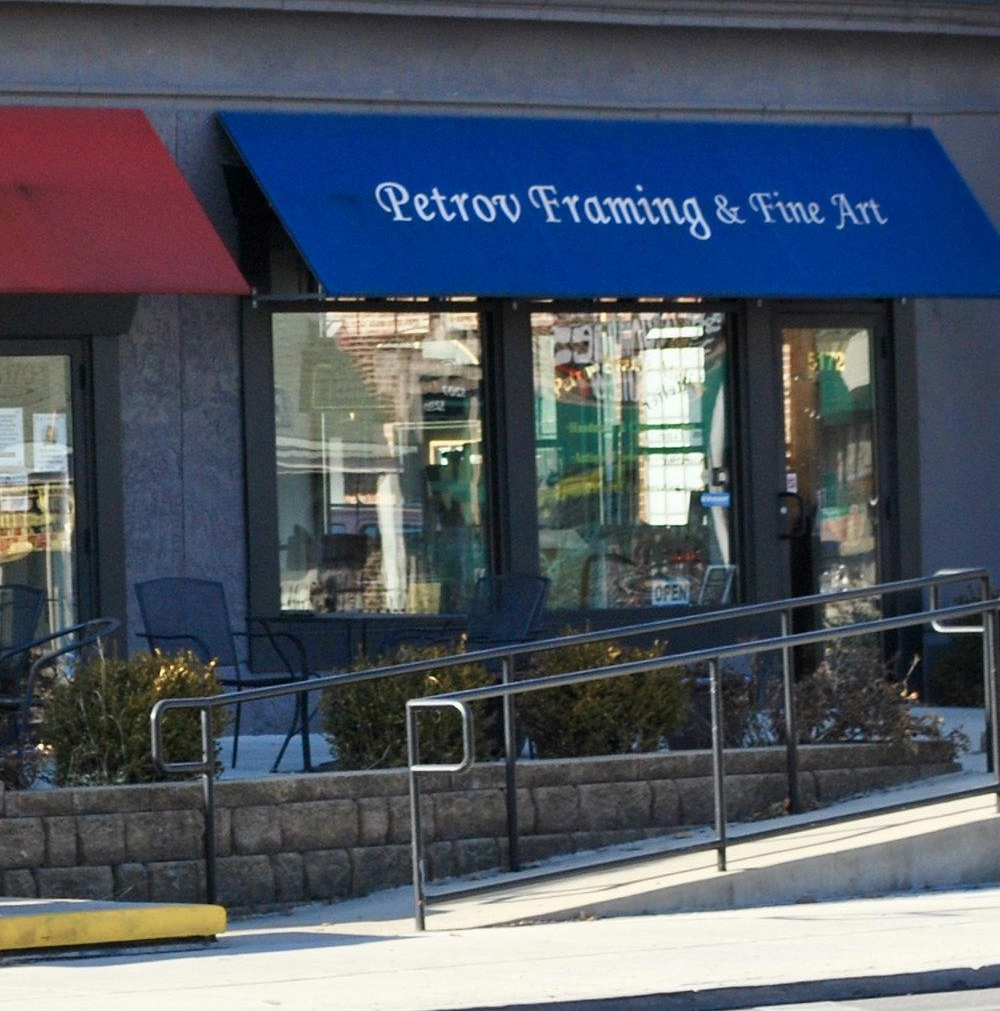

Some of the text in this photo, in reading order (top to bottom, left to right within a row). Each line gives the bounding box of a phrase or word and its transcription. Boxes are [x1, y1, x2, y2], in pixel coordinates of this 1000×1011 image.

[374, 181, 889, 241] Petrov Framing & Fine Art
[655, 582, 688, 602] OPEN
